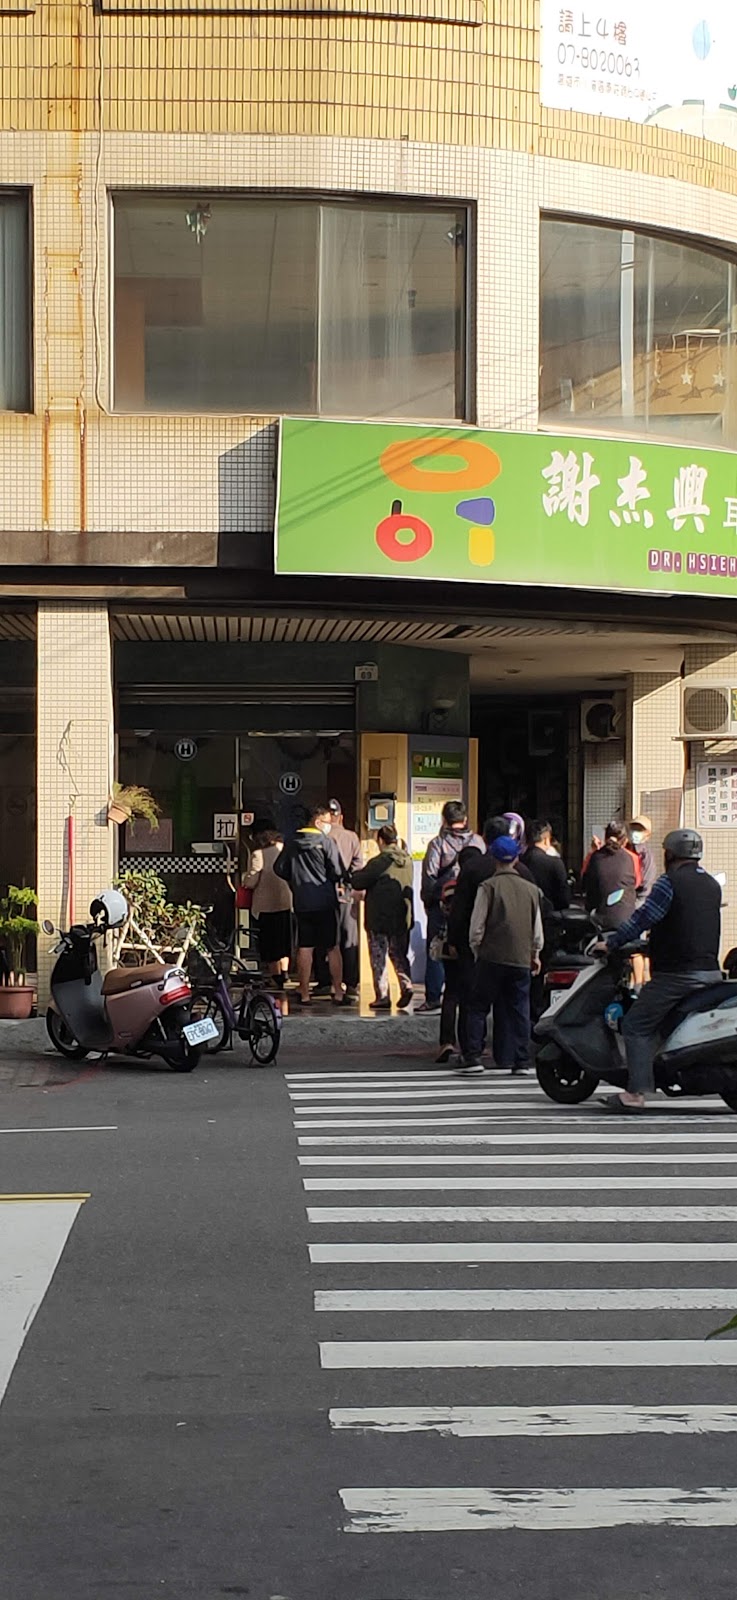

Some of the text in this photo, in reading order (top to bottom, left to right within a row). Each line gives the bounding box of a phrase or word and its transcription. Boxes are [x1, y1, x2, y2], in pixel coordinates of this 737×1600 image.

[540, 450, 711, 534] 謝杰興
[650, 550, 681, 570] DR.
[216, 818, 236, 838] 拉
